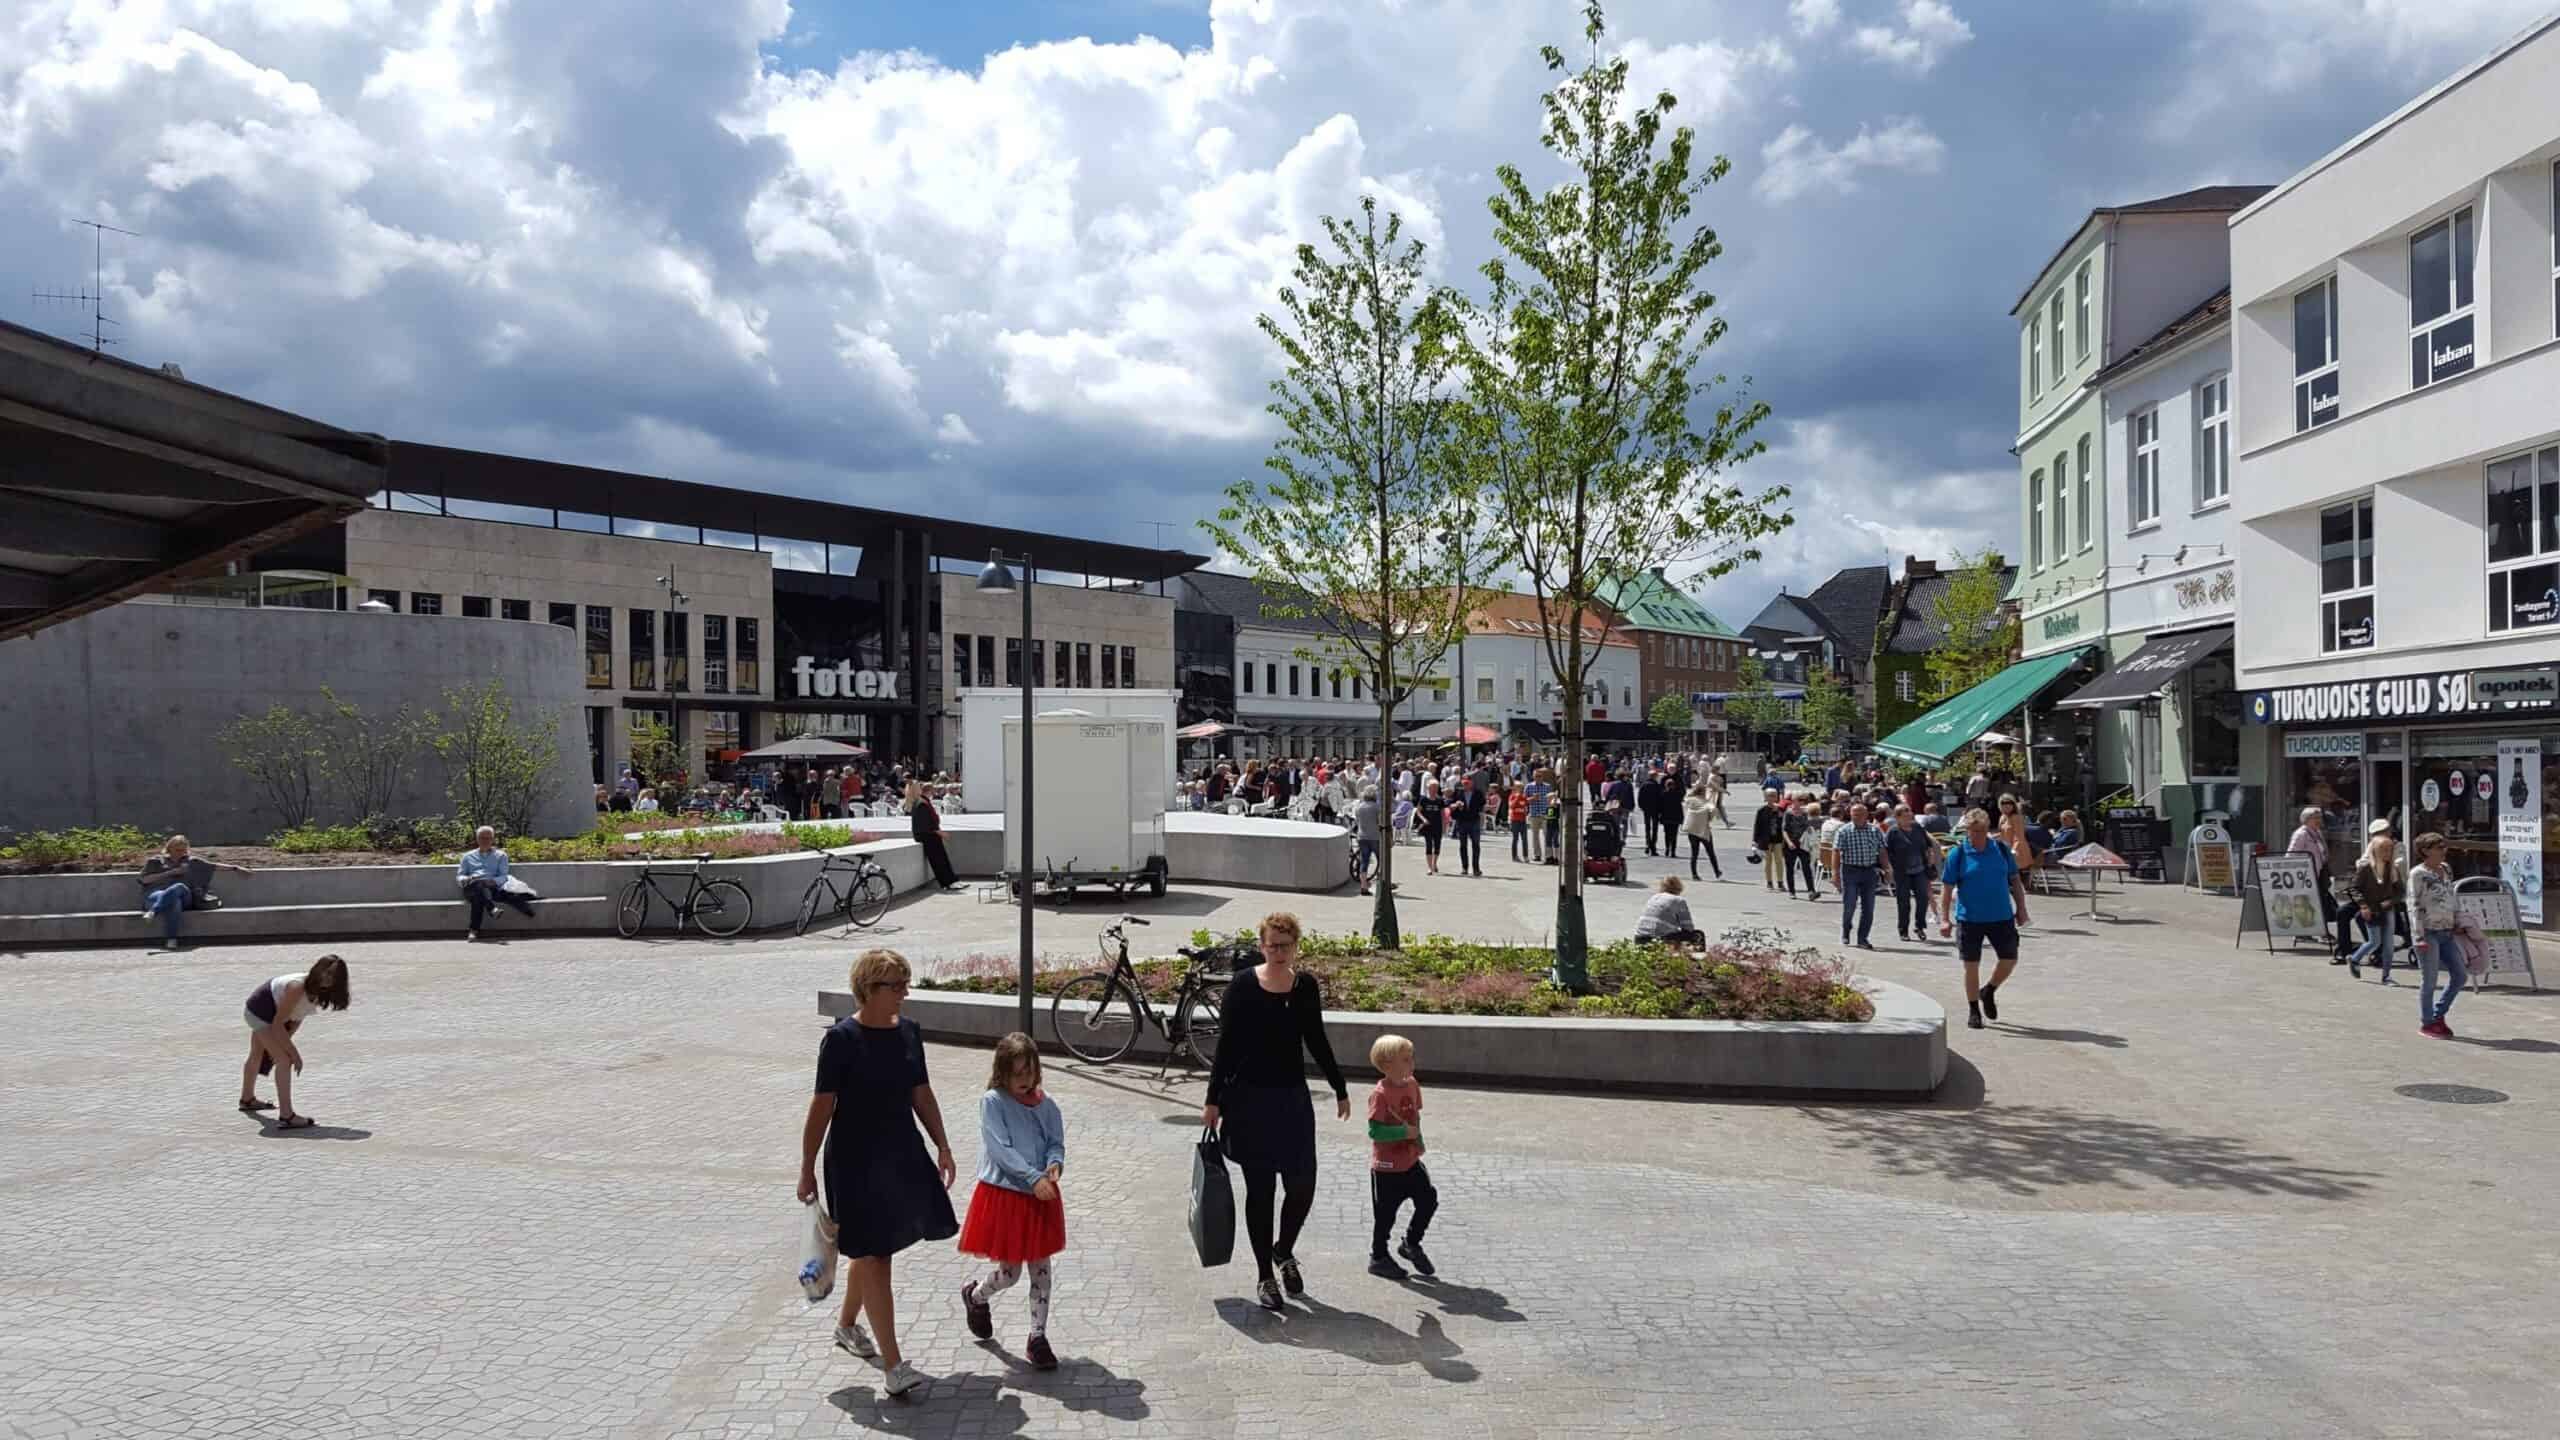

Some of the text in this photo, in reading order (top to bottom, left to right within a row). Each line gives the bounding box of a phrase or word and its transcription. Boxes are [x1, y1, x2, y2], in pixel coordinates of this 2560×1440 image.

[2433, 343, 2473, 367] laban
[792, 656, 898, 699] føtex
[2479, 677, 2555, 697] apotek
[2272, 684, 2371, 722] TURQUOISE
[2376, 679, 2431, 716] GULD
[2287, 735, 2361, 752] TURQUOISE
